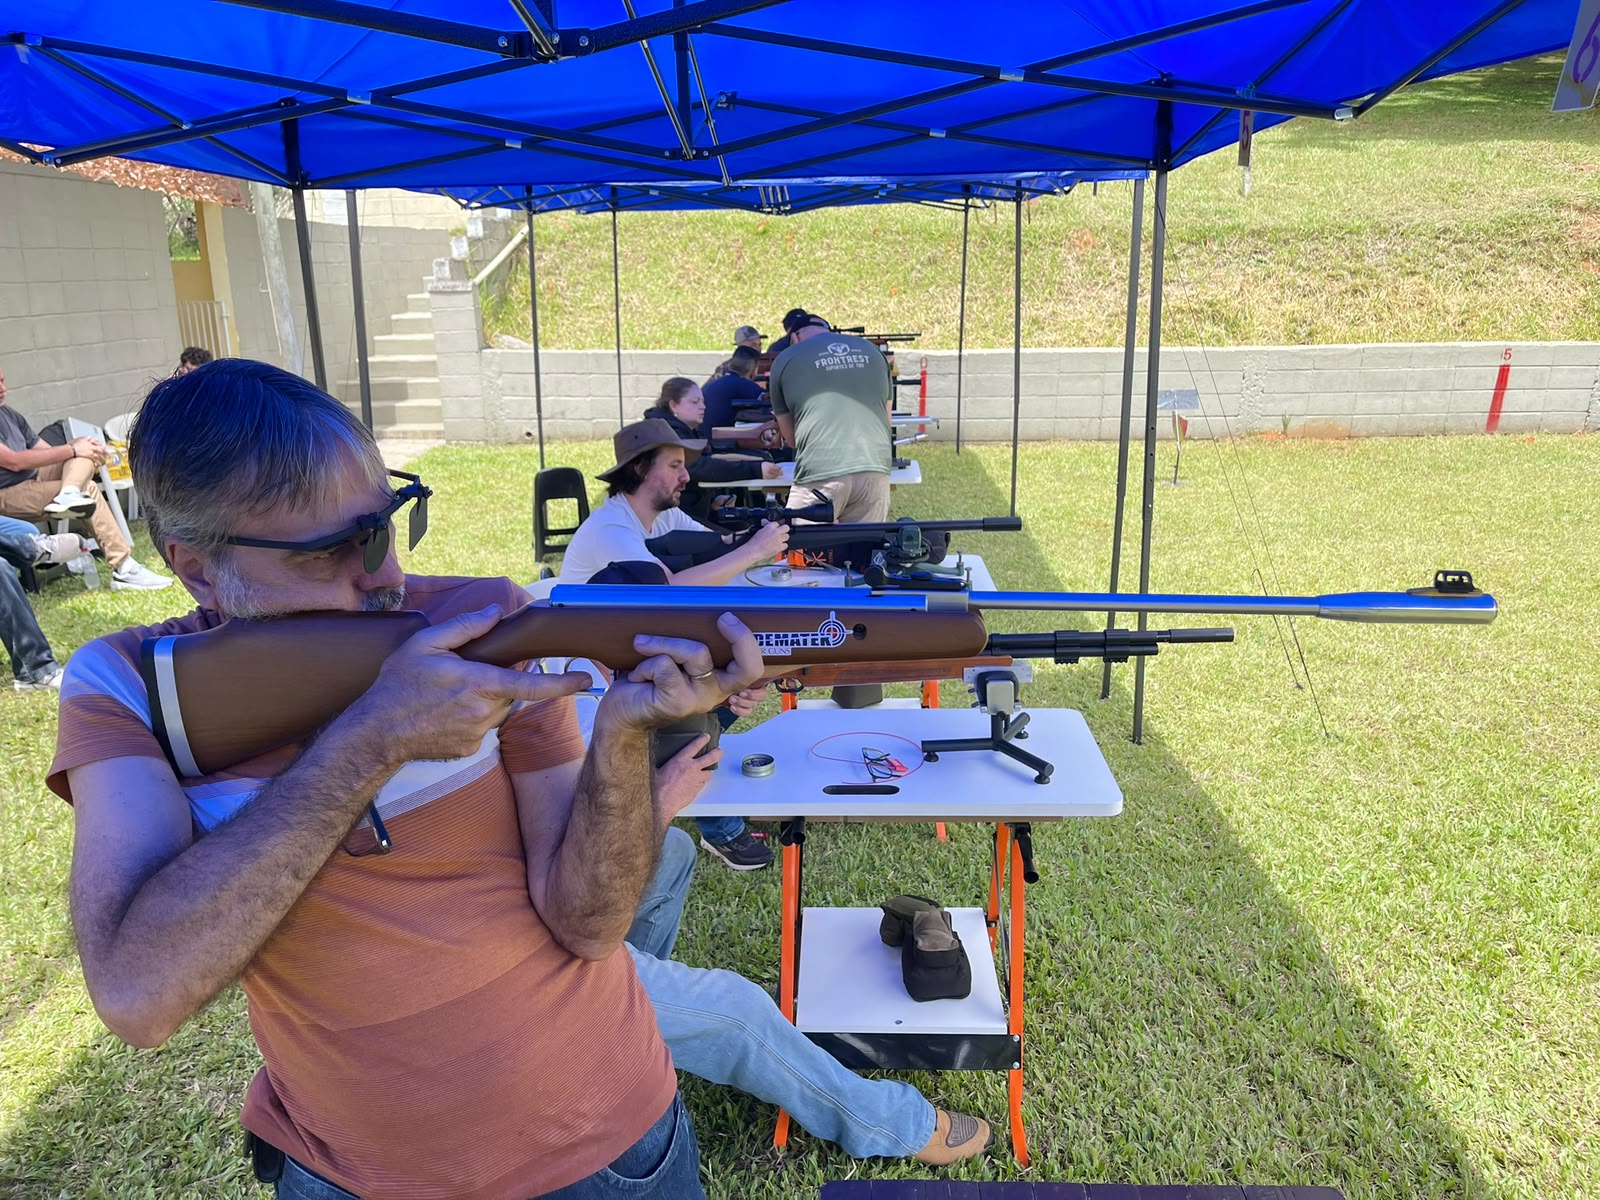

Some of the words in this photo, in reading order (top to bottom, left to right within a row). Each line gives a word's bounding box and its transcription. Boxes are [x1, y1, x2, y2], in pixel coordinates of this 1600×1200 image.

[1241, 110, 1250, 151] 5
[814, 354, 870, 369] FRONTREST
[752, 633, 831, 646] DEMATEK
